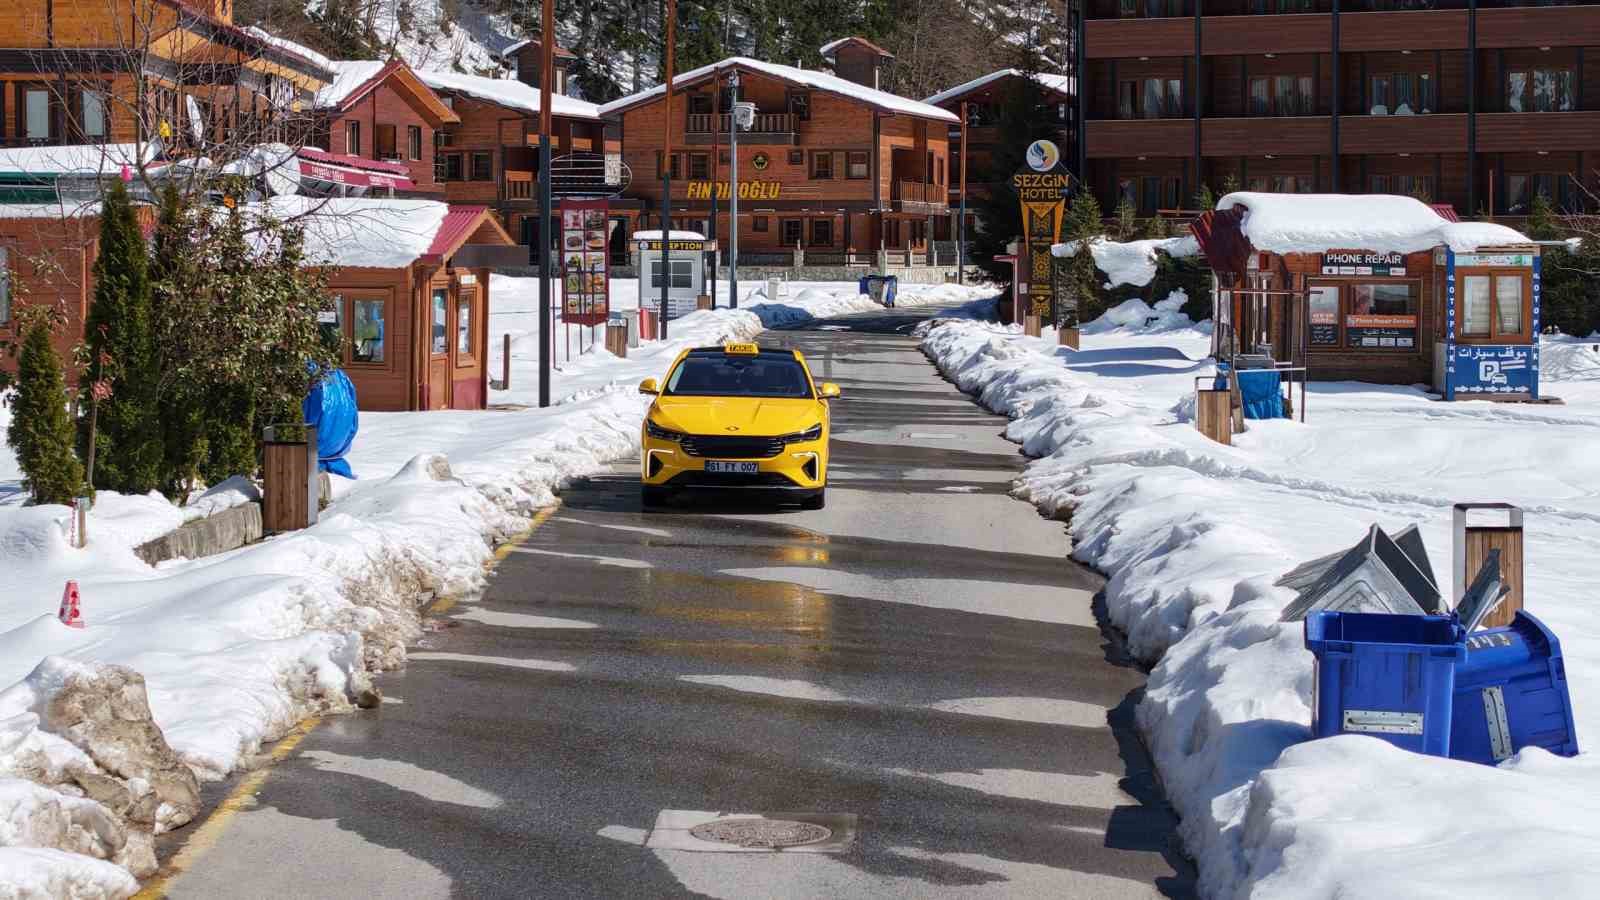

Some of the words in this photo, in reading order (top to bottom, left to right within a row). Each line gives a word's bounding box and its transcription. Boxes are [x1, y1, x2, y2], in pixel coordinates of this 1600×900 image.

[687, 180, 781, 199] FINDIOĞLU
[1020, 188, 1063, 200] HOTEL
[652, 242, 702, 250] REEPTION
[1326, 254, 1363, 264] PHONE
[1365, 254, 1402, 264] REPAIR
[1458, 347, 1496, 360] سيارات
[1498, 346, 1528, 360] موقف
[741, 462, 757, 472] 007
